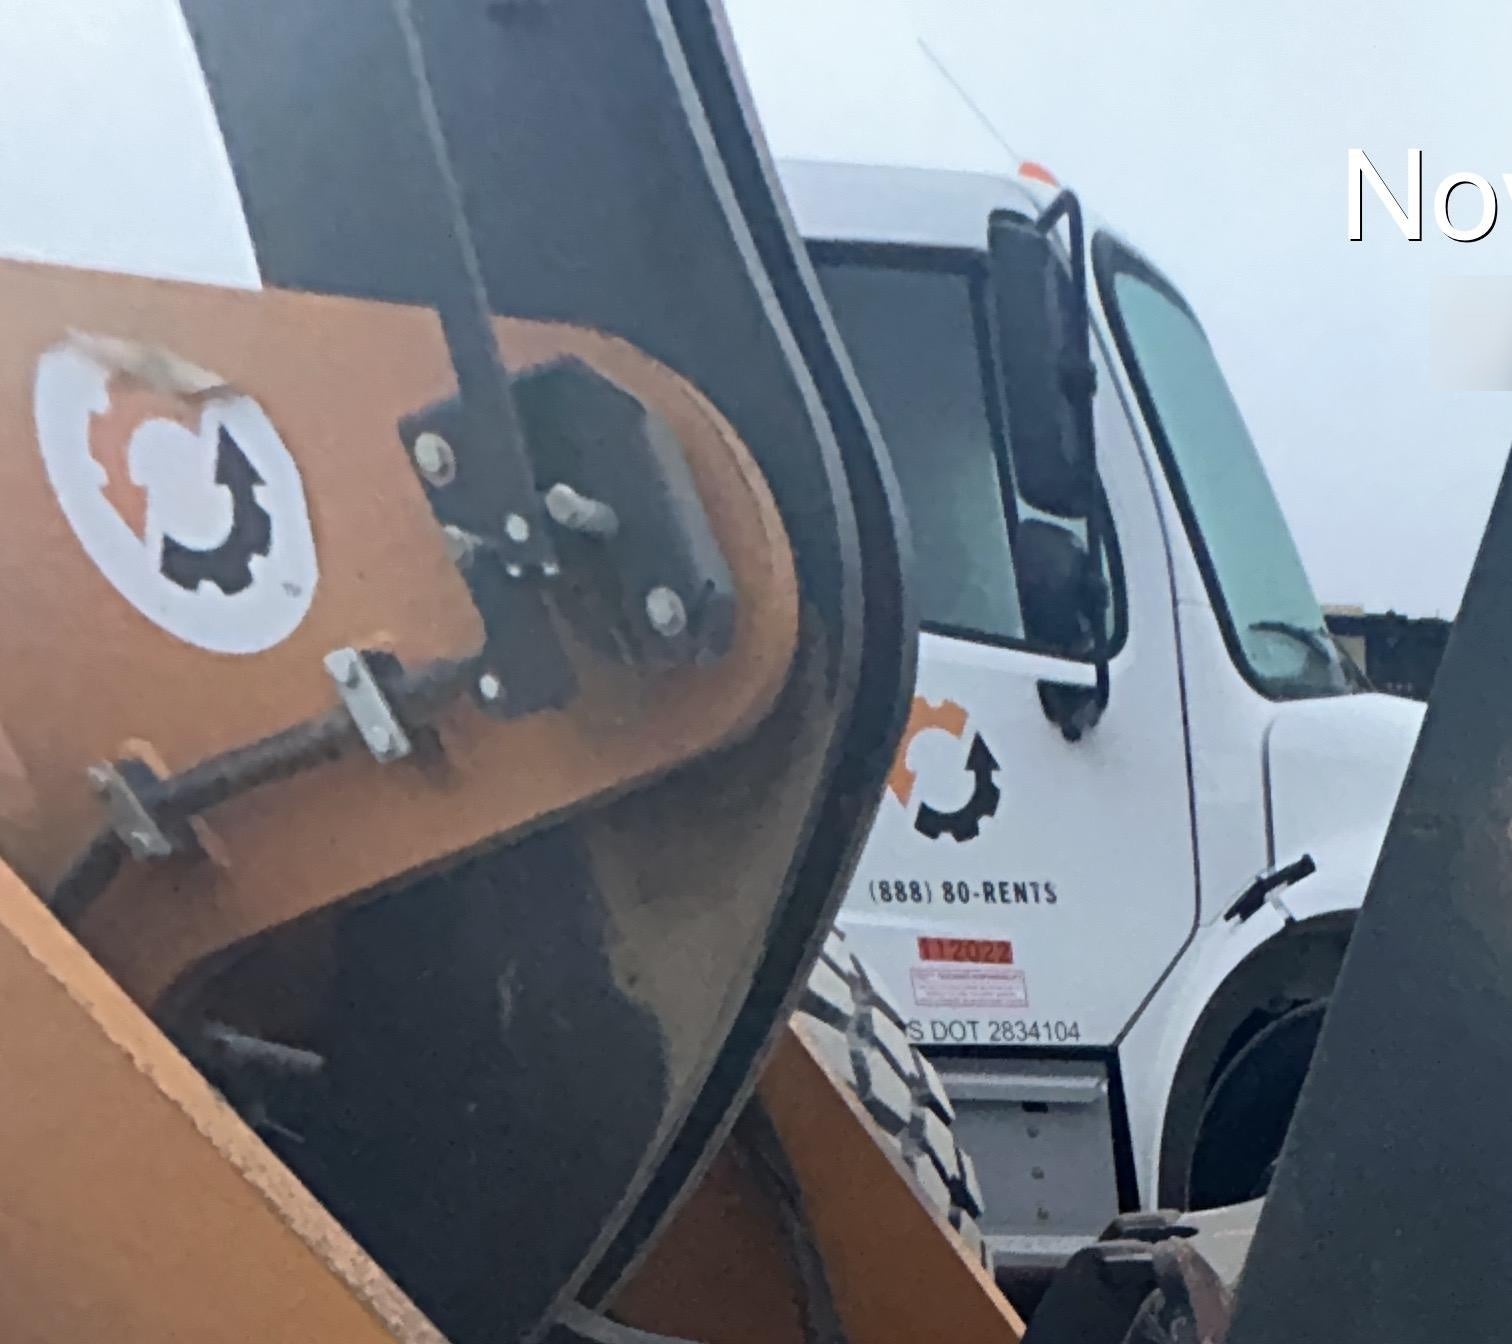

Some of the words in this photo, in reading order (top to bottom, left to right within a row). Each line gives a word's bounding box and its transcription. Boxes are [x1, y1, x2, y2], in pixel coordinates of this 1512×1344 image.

[868, 879, 932, 903] (888)
[941, 880, 1058, 904] 80-RENTS
[930, 1020, 980, 1041] DOT
[988, 1020, 1081, 1042] 2834104
